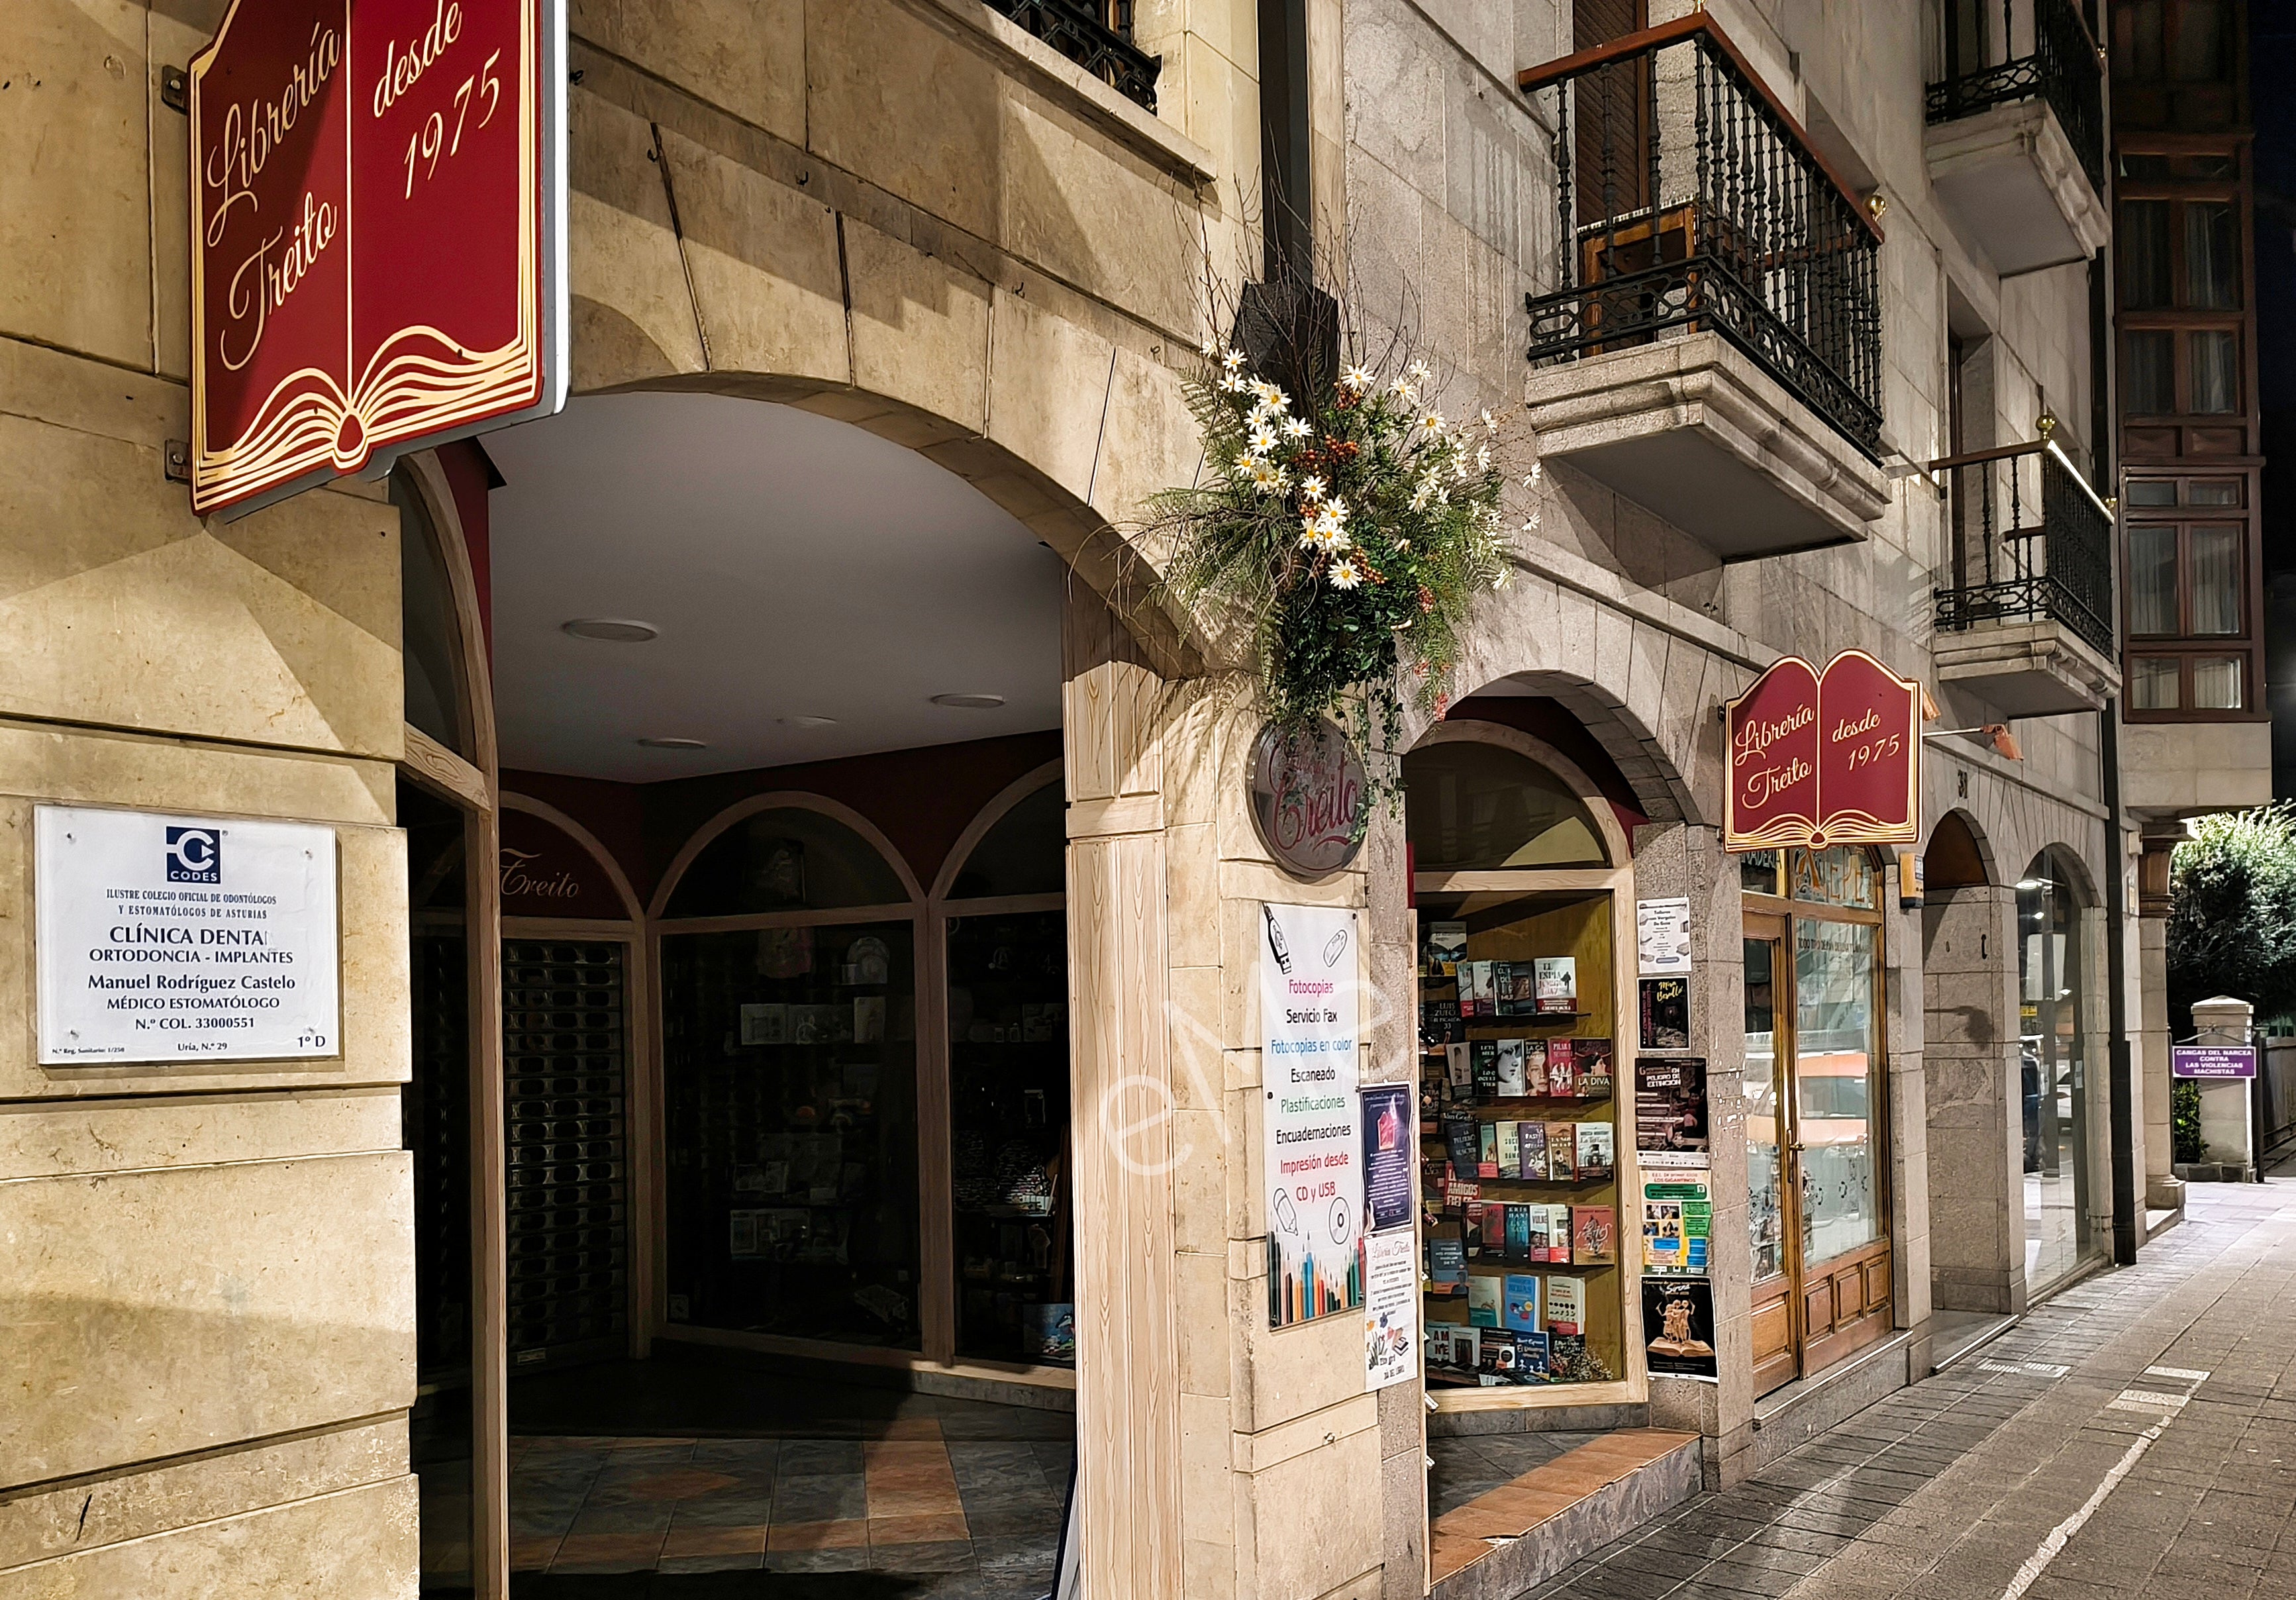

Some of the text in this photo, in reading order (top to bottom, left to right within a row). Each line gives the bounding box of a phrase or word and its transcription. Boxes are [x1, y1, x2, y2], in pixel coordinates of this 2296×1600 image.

[374, 0, 463, 119] desde
[405, 48, 501, 200] 1975
[207, 21, 340, 248] Librería
[221, 191, 338, 371] Treito
[1734, 703, 1815, 766] Librería
[1832, 708, 1881, 742] desde
[1848, 733, 1901, 771] 1975
[1742, 757, 1812, 809] Treito
[170, 870, 218, 881] CODES
[500, 848, 579, 899] Treito
[107, 889, 277, 905] ILUSTRE COLEGIO OFICIAL DE ODONTÓLOGOS
[119, 904, 267, 919] Y ESTOMATÓLOGOS DE ASTURIAS
[110, 923, 193, 944] CLÍNICA
[89, 948, 201, 963] ORTODONCIA
[215, 950, 293, 964] IMPLANTES
[88, 974, 296, 993] Manuel Rodríguez Castelo
[1289, 979, 1334, 997] Fotocopias
[107, 997, 280, 1009] MÉDICO ESTOMATÓLOGO
[160, 1018, 191, 1029] COL.
[195, 1017, 255, 1029] 33000551
[1286, 1008, 1338, 1024] Servicio Fax
[217, 1042, 228, 1051] 29
[315, 1035, 326, 1048] D
[1271, 1036, 1352, 1056] Fotocopias en color
[1291, 1066, 1336, 1083] Escaneado
[1591, 1077, 1610, 1085] DIVA
[1281, 1095, 1346, 1114] Plastificaciones
[1276, 1123, 1351, 1144] Encuadernaciones
[1280, 1151, 1349, 1177] Impresión desde
[1296, 1181, 1336, 1203] CD y USB
[1447, 1182, 1478, 1195] AMIGOS
